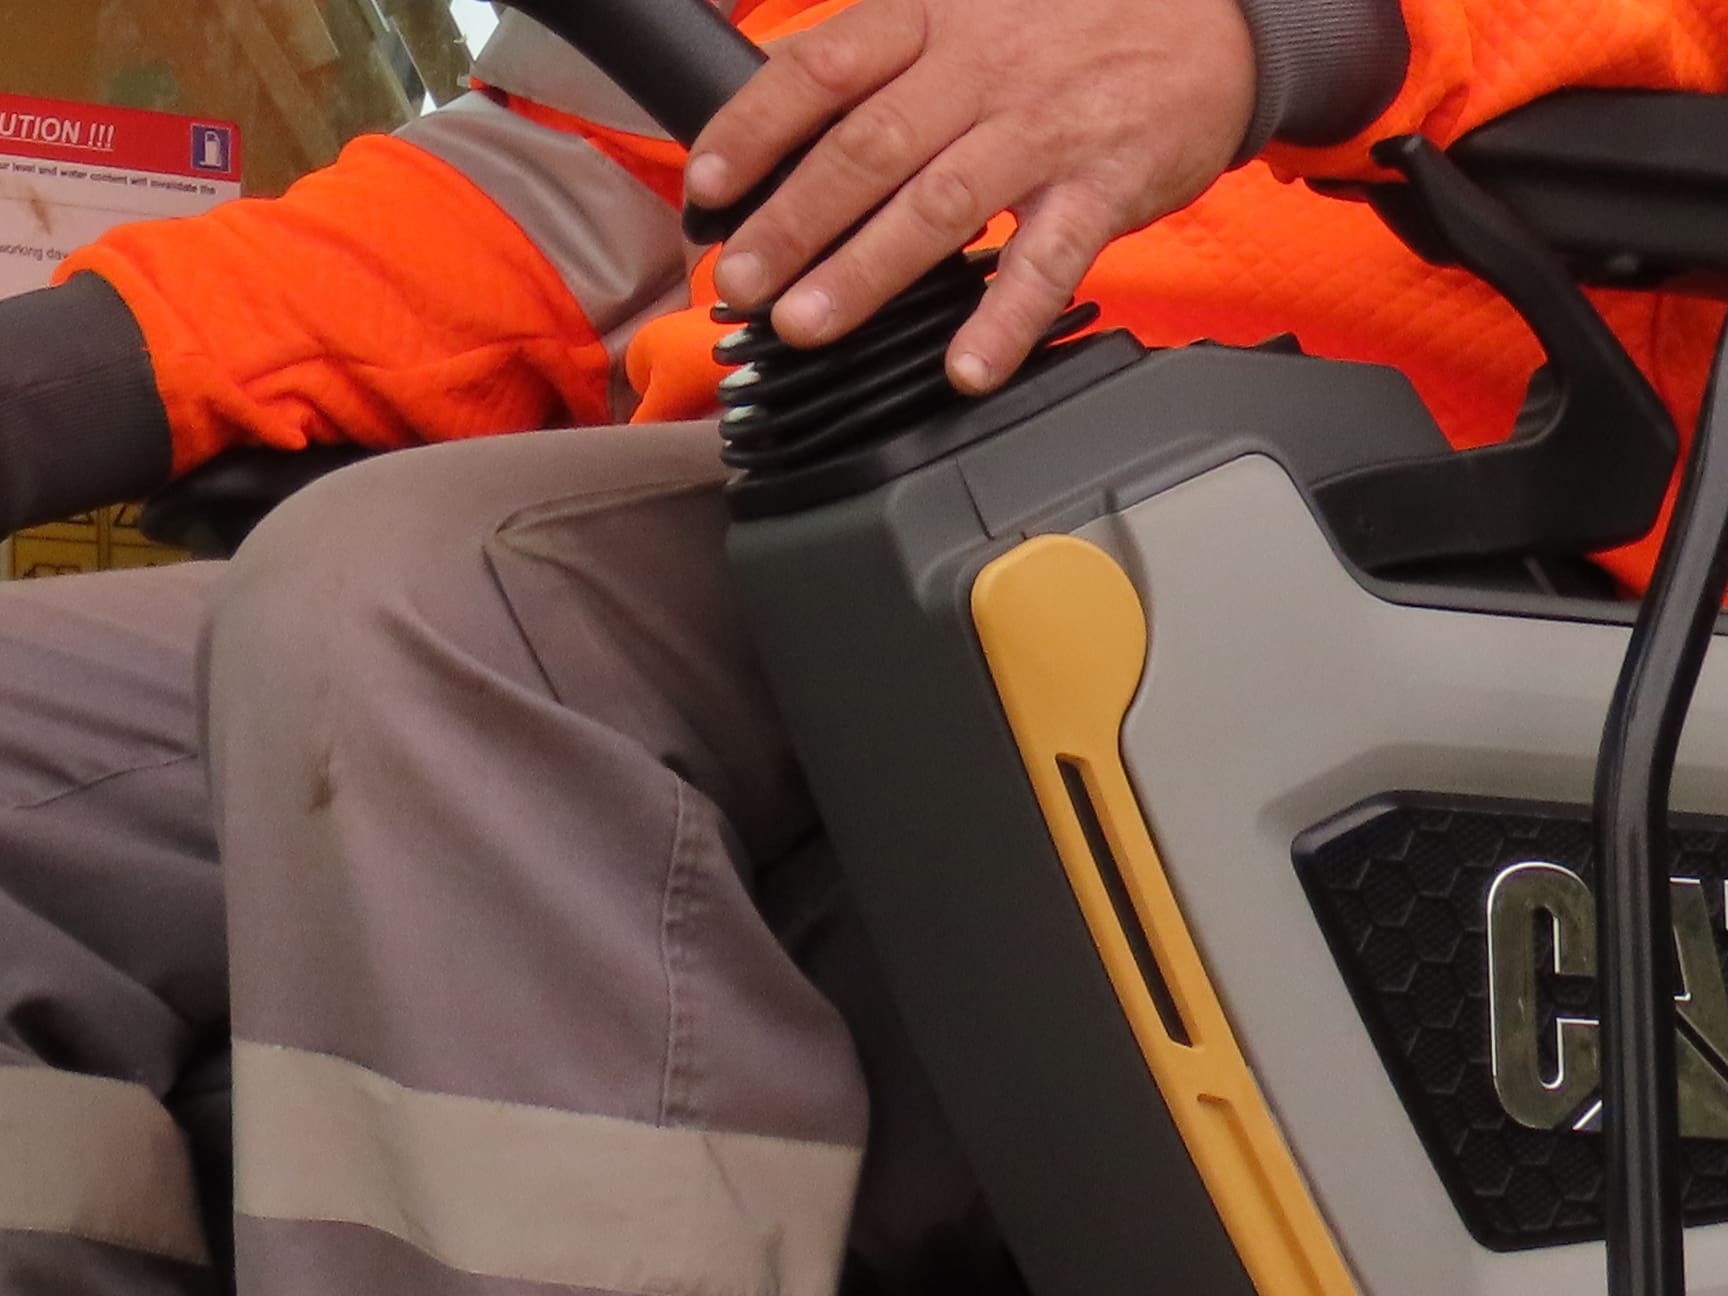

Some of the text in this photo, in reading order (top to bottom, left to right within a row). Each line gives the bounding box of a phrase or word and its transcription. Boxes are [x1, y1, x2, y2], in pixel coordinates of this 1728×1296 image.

[12, 162, 36, 173] level
[38, 165, 57, 176] and
[90, 172, 128, 186] content
[130, 175, 148, 187] will
[150, 178, 198, 193] invalidate
[200, 183, 217, 196] the
